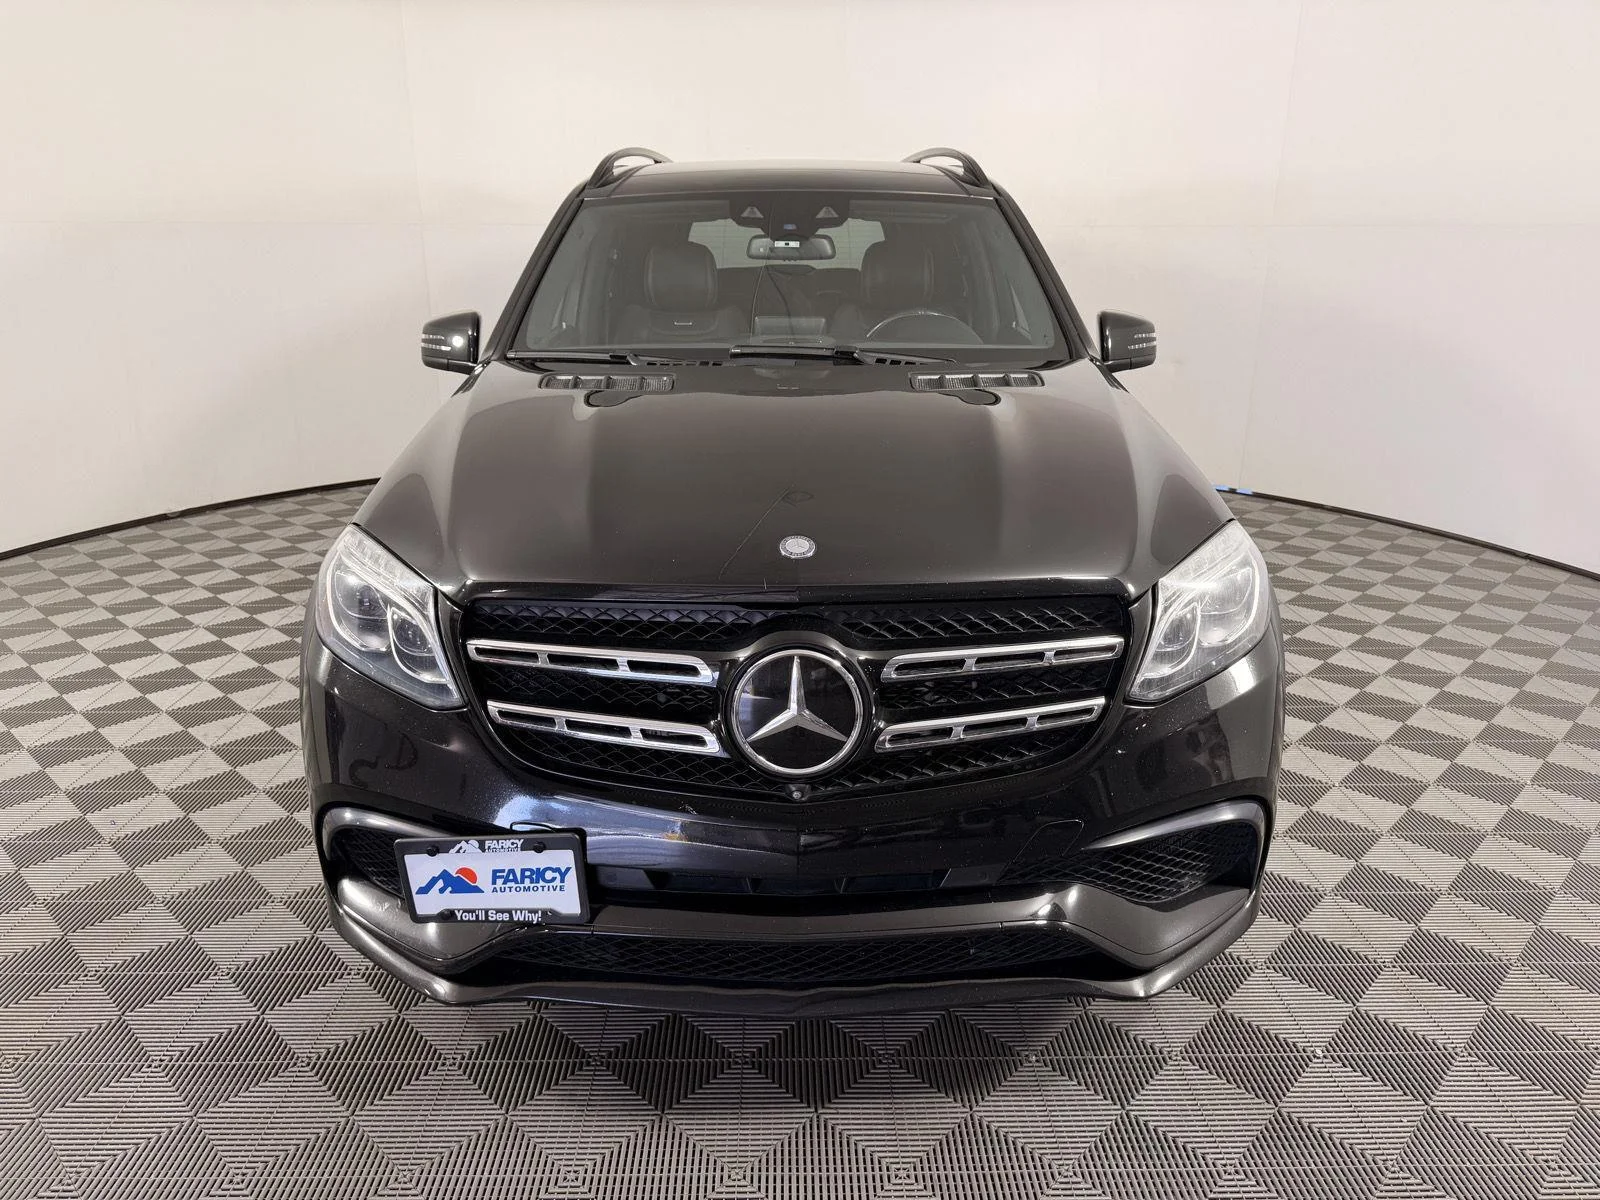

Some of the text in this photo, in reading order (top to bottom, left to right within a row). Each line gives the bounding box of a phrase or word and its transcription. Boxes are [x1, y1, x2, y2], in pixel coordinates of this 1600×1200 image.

[485, 839, 524, 849] FARICY
[491, 866, 572, 885] FARICY
[491, 885, 566, 893] AUTOMOTIVE
[454, 909, 542, 924] You'll See Why!
